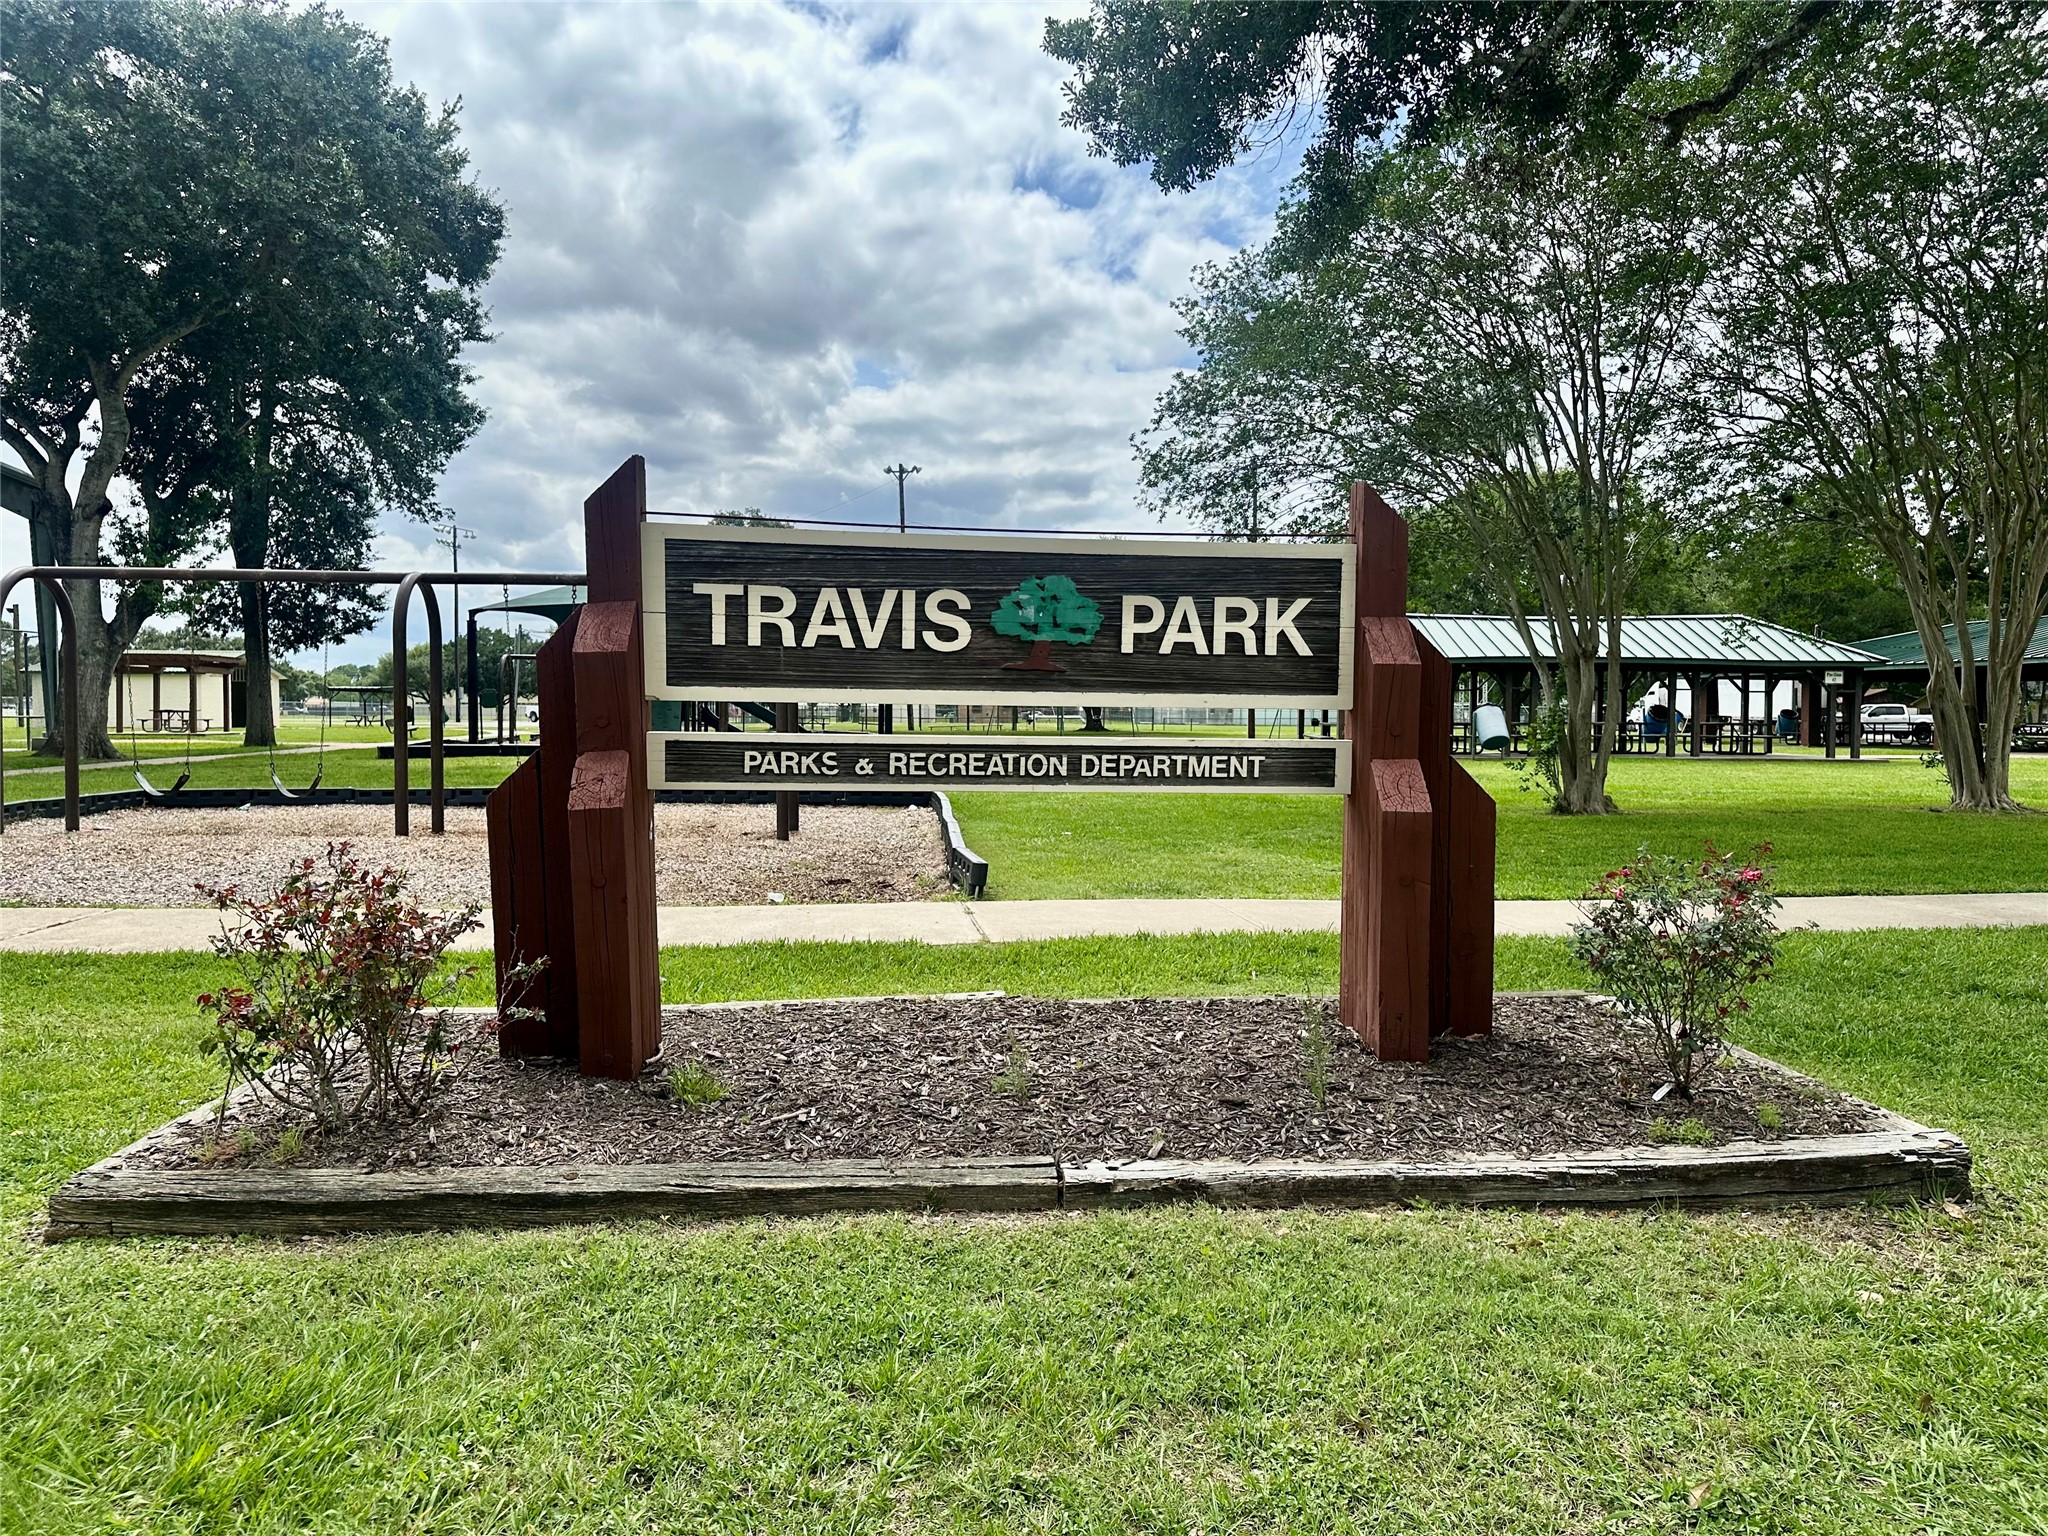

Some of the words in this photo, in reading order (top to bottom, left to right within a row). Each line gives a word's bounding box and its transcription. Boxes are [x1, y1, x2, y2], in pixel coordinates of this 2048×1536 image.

[692, 582, 972, 653] TRAVIS
[1120, 595, 1314, 657] PARK
[744, 751, 840, 776] PARKS
[854, 757, 875, 776] &
[888, 752, 1068, 777] RECREATION
[1080, 753, 1266, 779] DEPARTMENT
